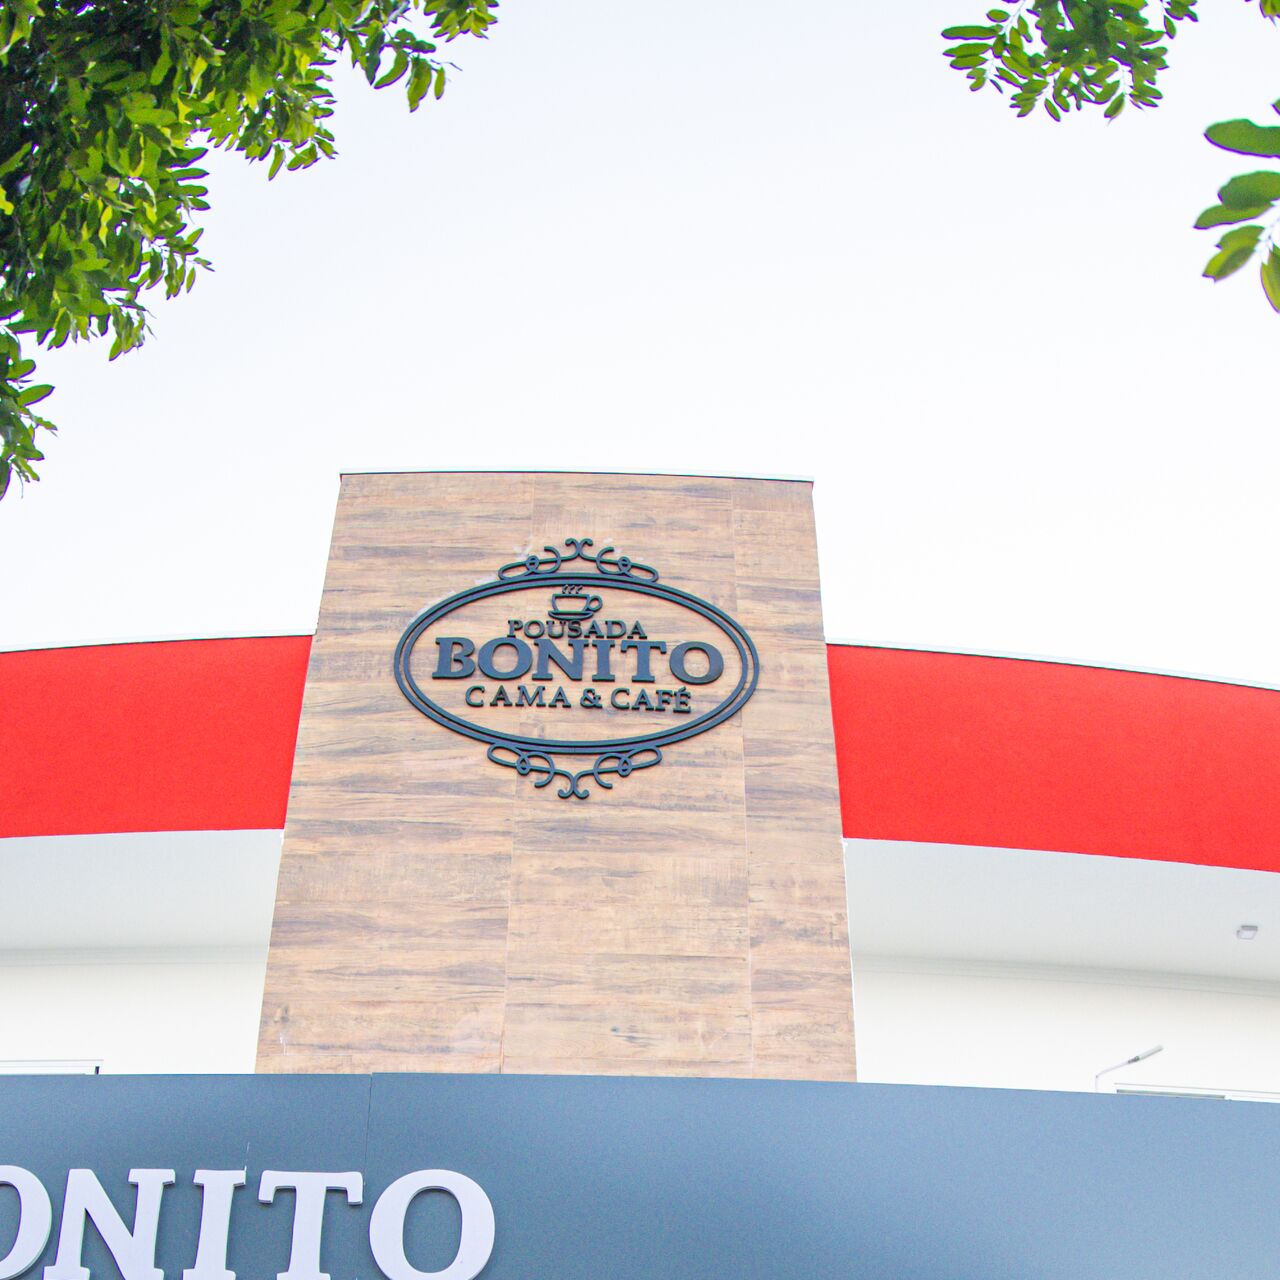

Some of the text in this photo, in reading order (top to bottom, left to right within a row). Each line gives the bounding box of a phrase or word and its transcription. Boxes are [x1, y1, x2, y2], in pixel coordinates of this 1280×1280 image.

[507, 619, 647, 639] POUSADA
[431, 637, 725, 685] BONITO
[465, 685, 693, 714] CAMA & CAFÉ
